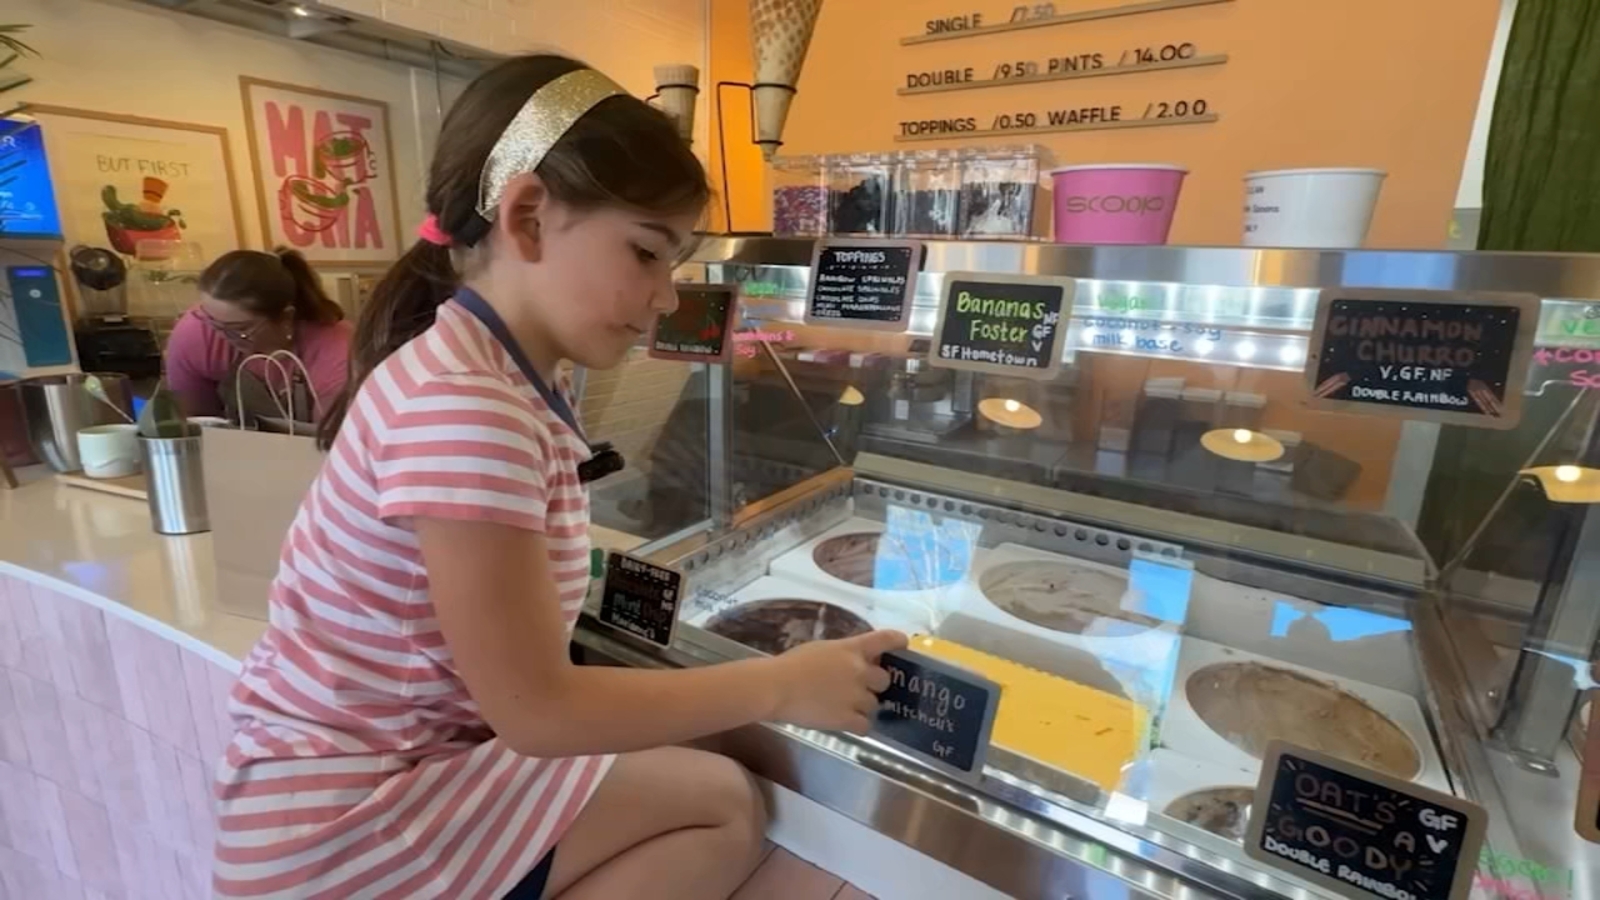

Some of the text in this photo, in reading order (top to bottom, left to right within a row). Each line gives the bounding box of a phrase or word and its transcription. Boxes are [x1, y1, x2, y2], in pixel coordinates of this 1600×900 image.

[926, 13, 982, 35] SINGLE
[907, 67, 974, 88] DOUBLE
[1048, 53, 1103, 74] PINTS
[899, 117, 976, 136] TOPPINGS
[1048, 105, 1122, 126] WAFFLE
[96, 155, 189, 178] BUT FIRST
[957, 291, 1046, 321] Bananas
[970, 319, 1052, 343] Foster GF
[1329, 315, 1483, 342] CINNAMON
[1093, 332, 1184, 352] milk base
[1356, 339, 1476, 368] CHURRO
[941, 344, 1038, 368] SF Hometown
[1352, 385, 1469, 406] DOUBLE RAINBOW
[888, 665, 967, 717] mango
[1418, 808, 1459, 832] GF
[1264, 835, 1332, 874] DOUBLE
[1425, 834, 1449, 855] V
